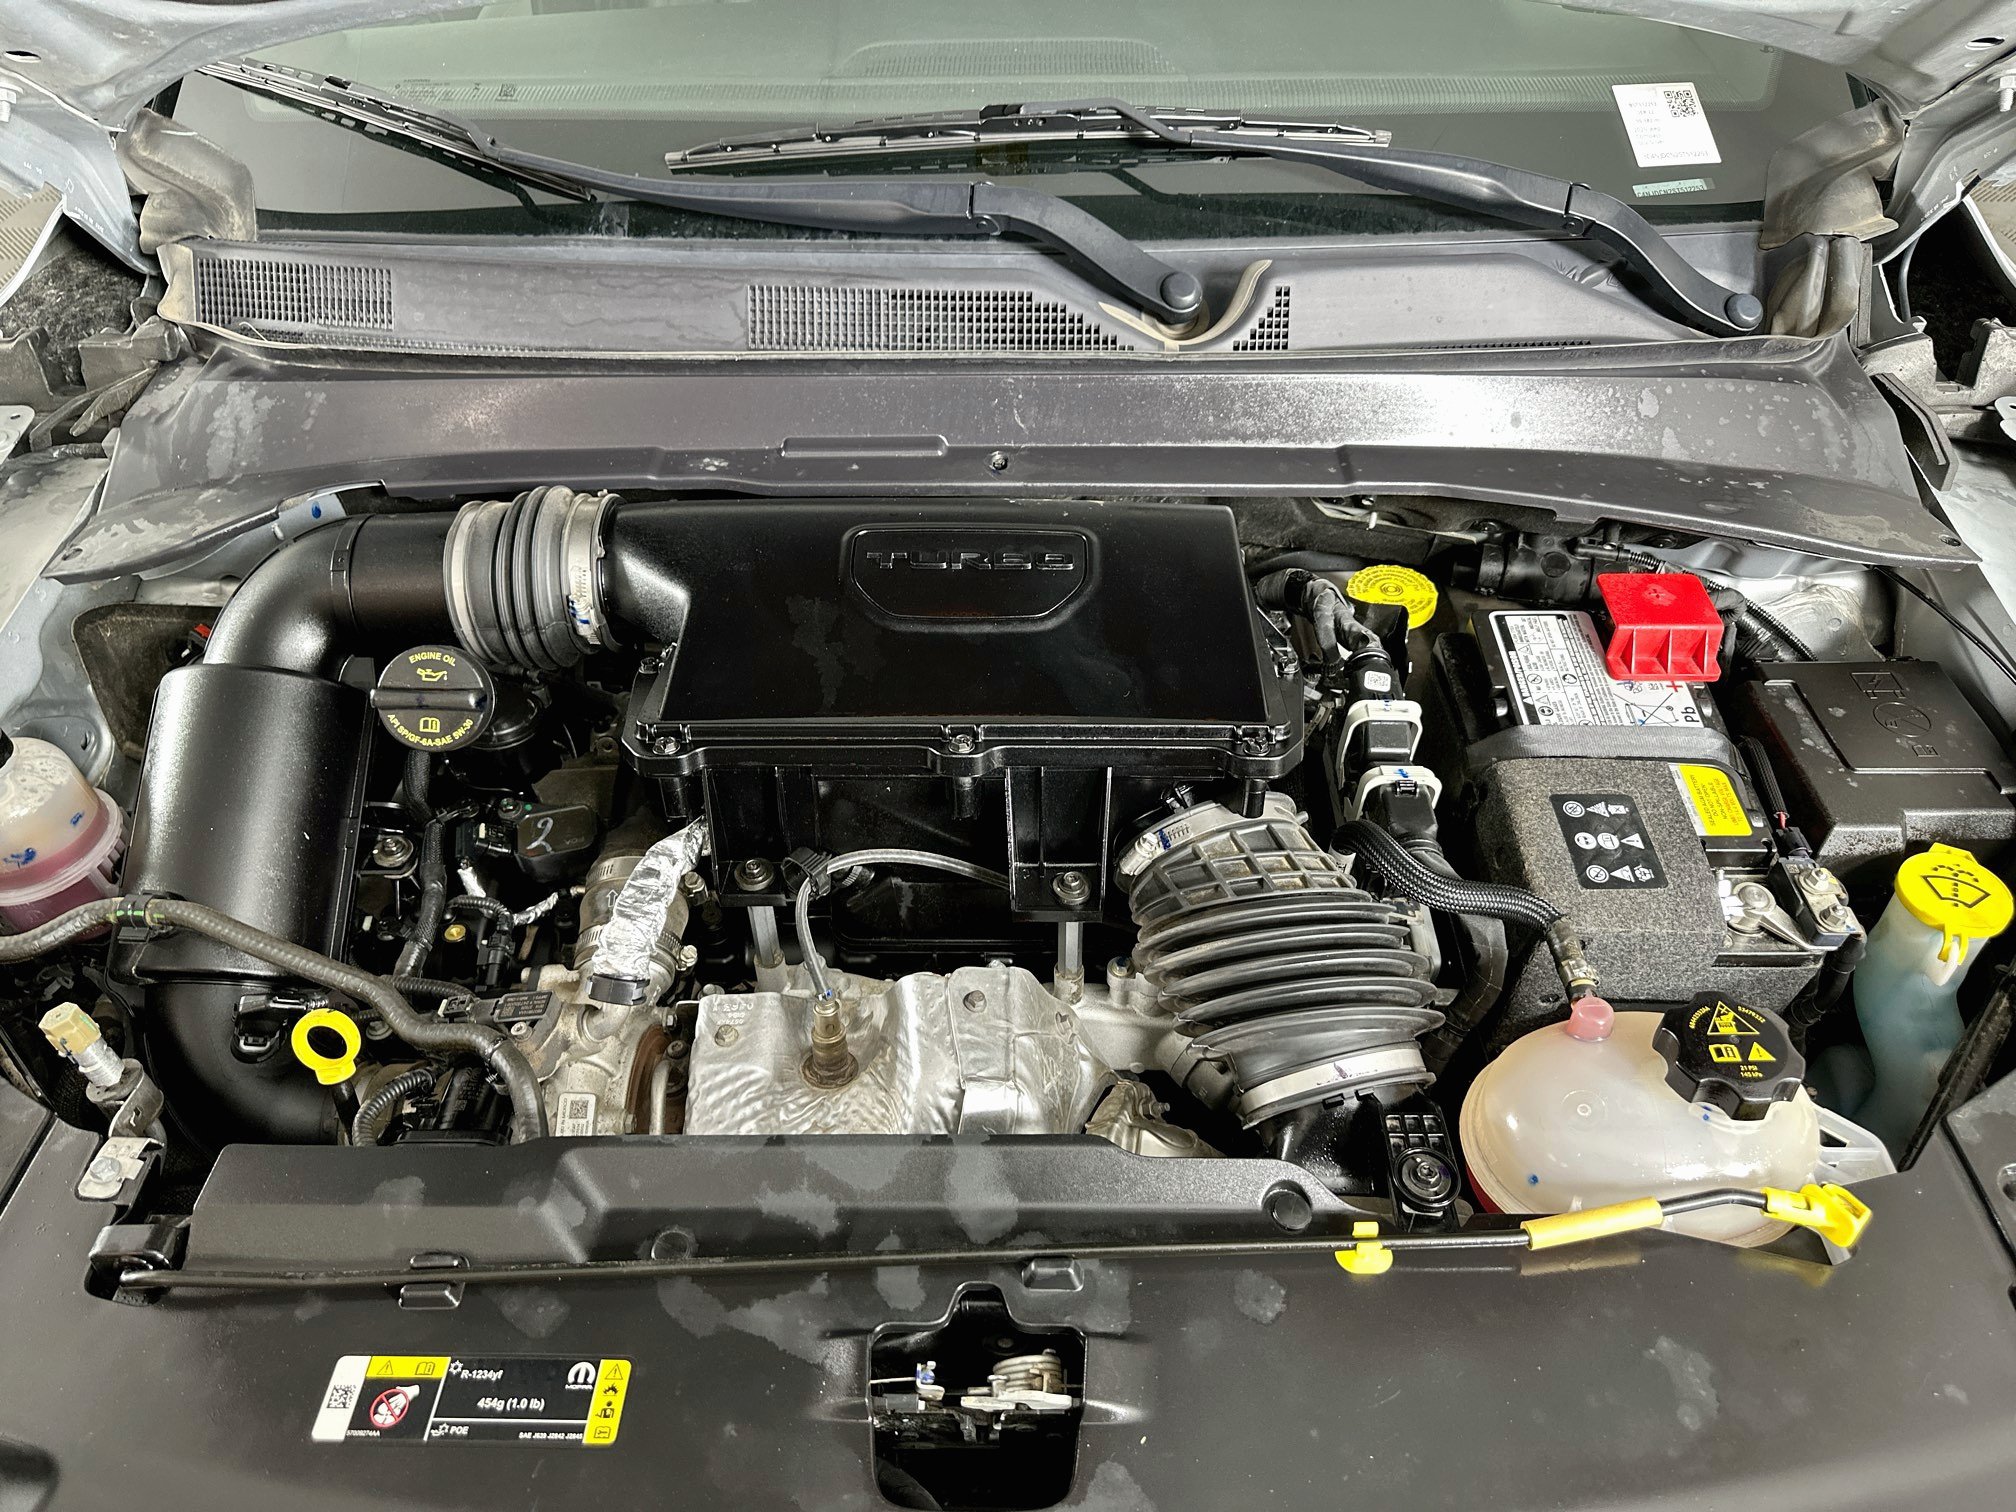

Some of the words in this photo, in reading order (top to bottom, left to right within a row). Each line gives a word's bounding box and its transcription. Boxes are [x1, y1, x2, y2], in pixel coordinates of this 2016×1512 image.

[866, 552, 1074, 570] TURBO
[409, 652, 442, 664] ENGINE
[442, 655, 456, 666] OIL
[1680, 706, 1700, 722] Pb
[388, 714, 400, 728] API
[452, 718, 474, 737] 5W-30
[526, 816, 554, 852] 2
[460, 1369, 504, 1380] R-1234yf
[476, 1397, 504, 1410] 454g
[506, 1398, 527, 1410] (1.0
[529, 1398, 545, 1412] lb)
[450, 1426, 470, 1435] POE
